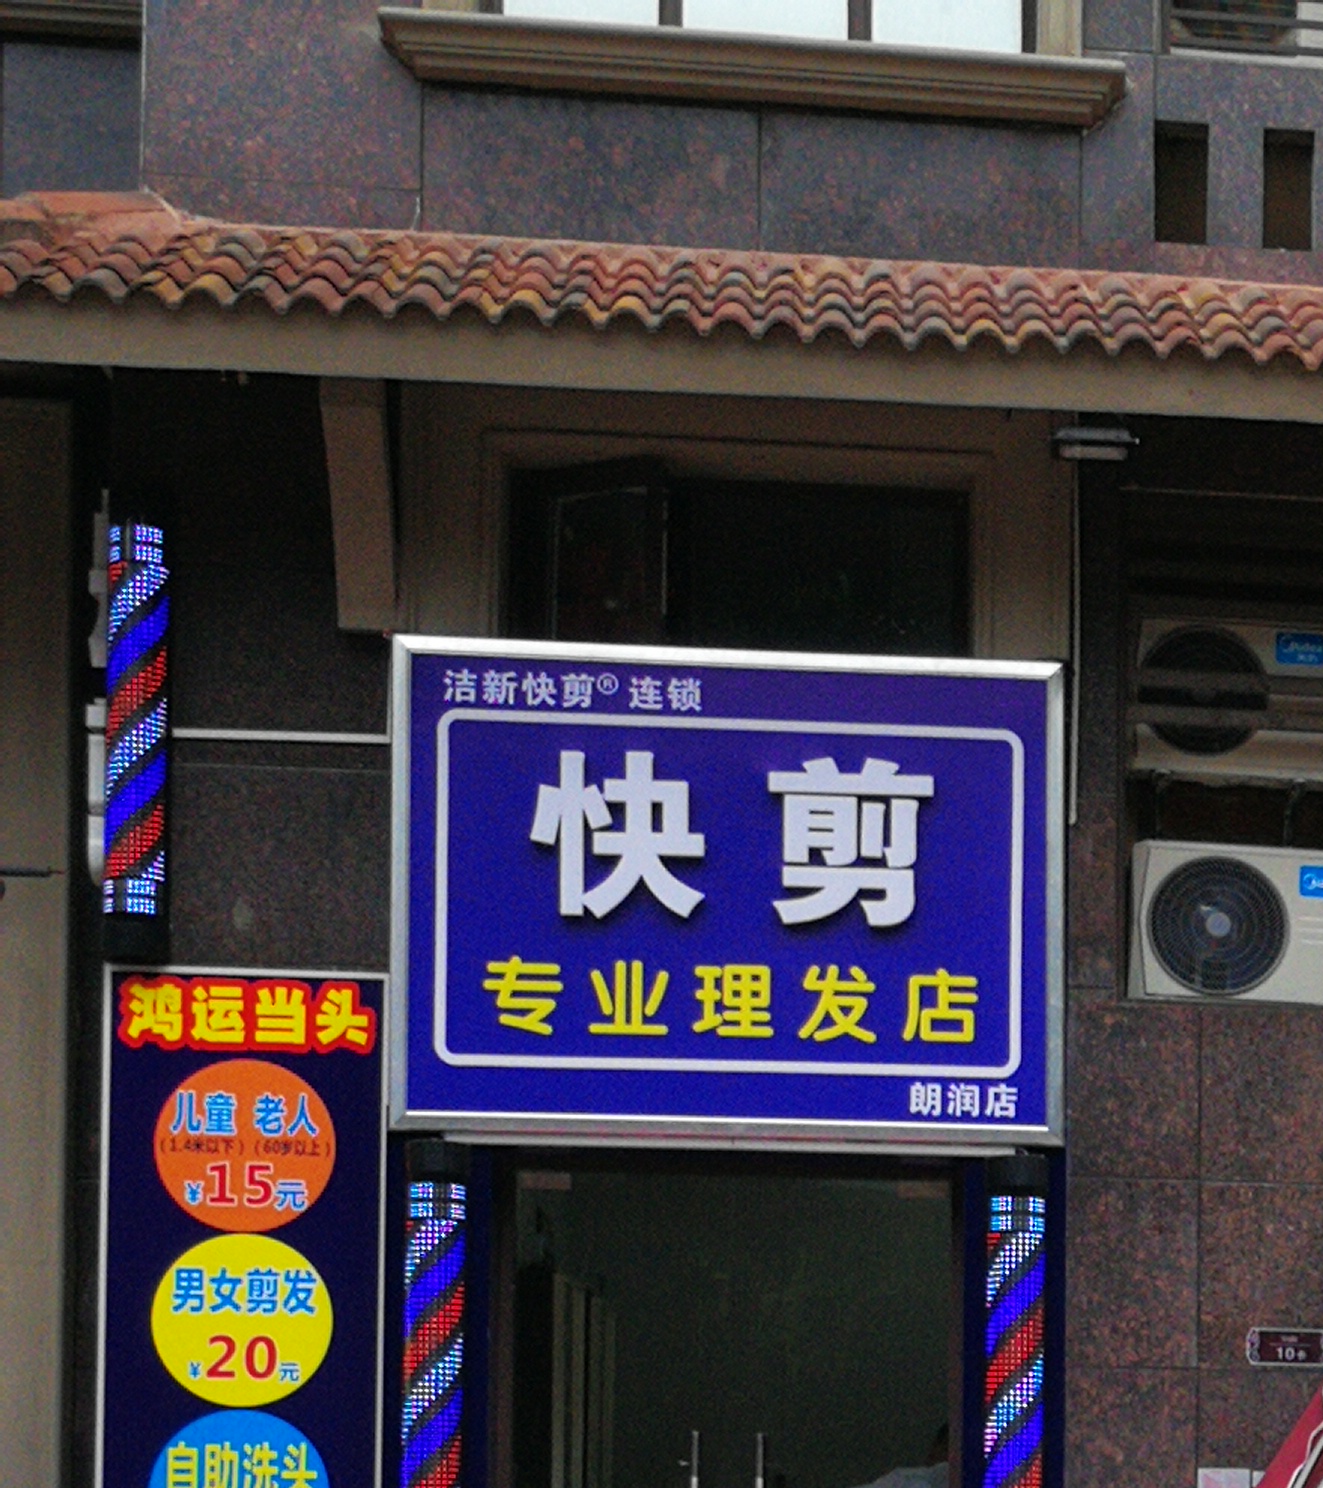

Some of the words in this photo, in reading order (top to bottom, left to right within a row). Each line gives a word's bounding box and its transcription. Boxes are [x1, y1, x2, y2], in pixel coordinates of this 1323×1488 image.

[629, 676, 703, 711] 连锁
[529, 750, 934, 927] 快剪
[125, 982, 370, 1047] 鸿运当头
[483, 955, 978, 1044] 专业理发店
[171, 1091, 237, 1134] 儿童
[254, 1093, 318, 1136] 老人
[909, 1081, 1018, 1118] 朗润店
[172, 1267, 317, 1315] 男女剪发
